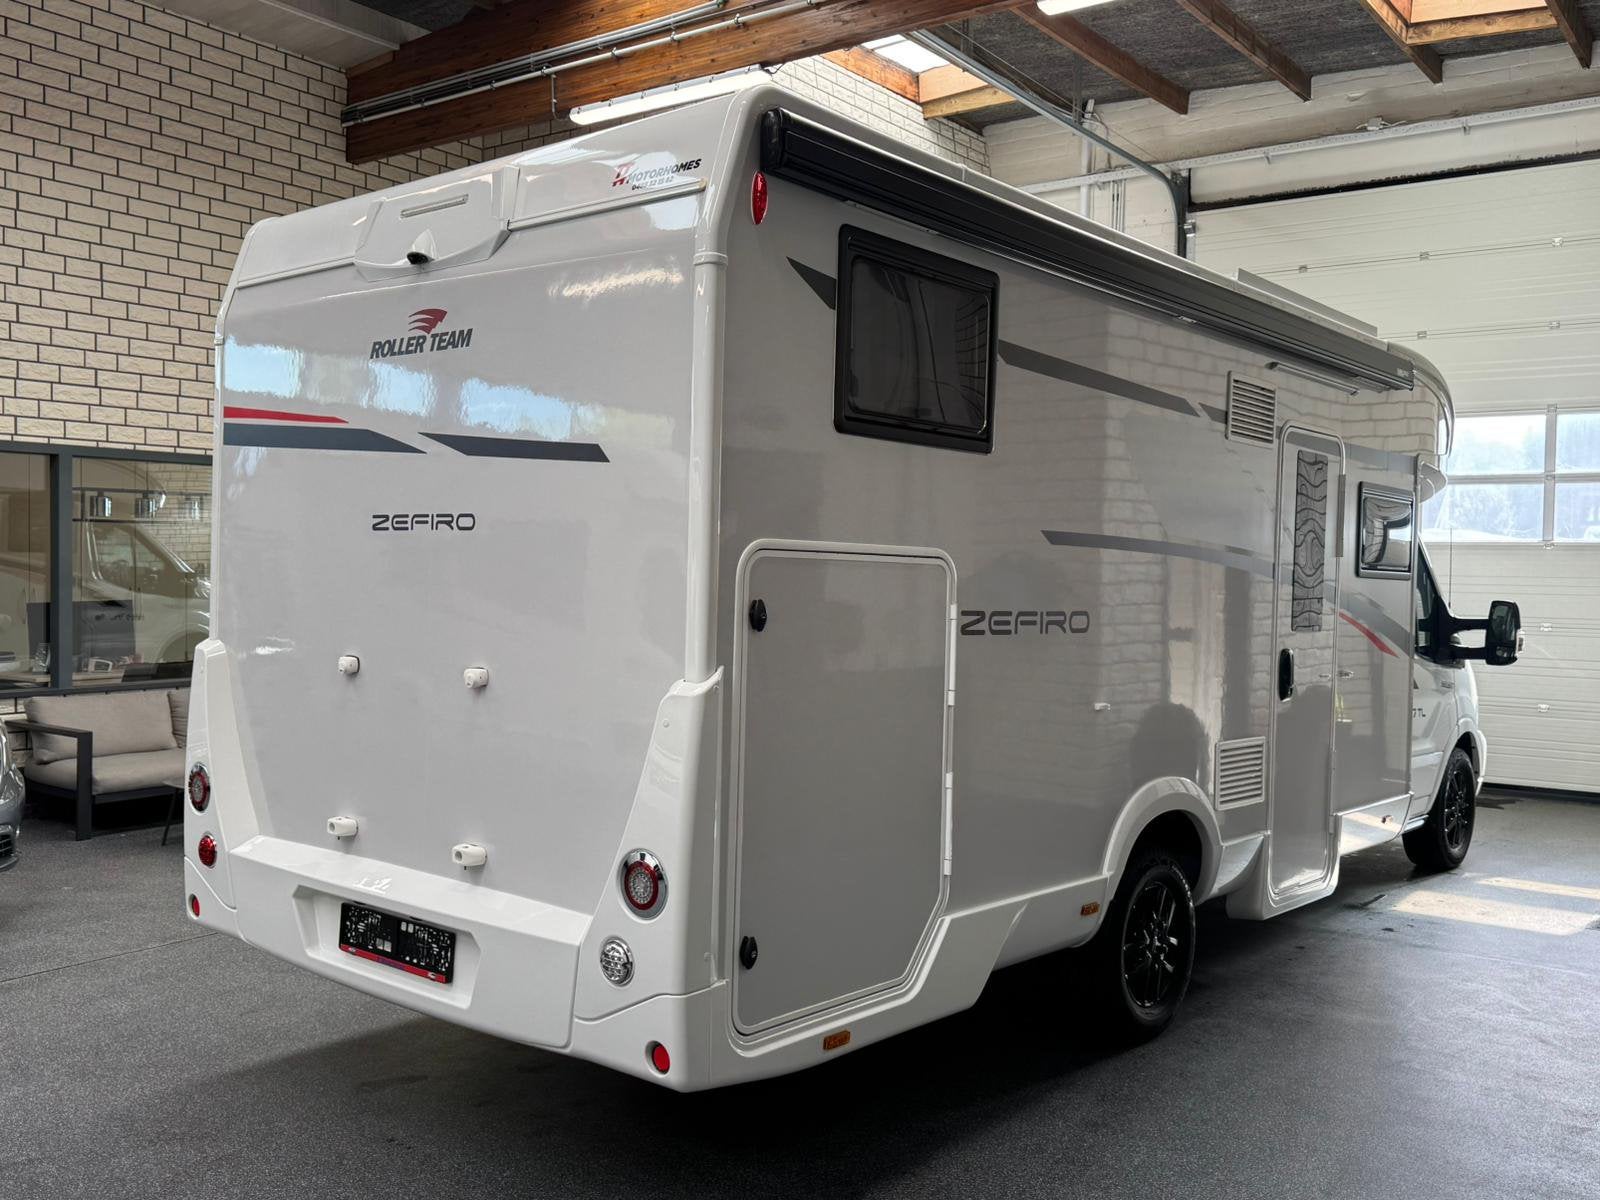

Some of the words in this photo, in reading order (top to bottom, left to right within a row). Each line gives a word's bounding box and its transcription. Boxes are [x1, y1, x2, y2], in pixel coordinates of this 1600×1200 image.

[629, 158, 702, 183] MOTORHOMES
[370, 335, 427, 359] ROLLER
[430, 328, 473, 352] TEAM
[372, 513, 476, 531] ZEFIRO
[960, 610, 1090, 635] ZEFIRO
